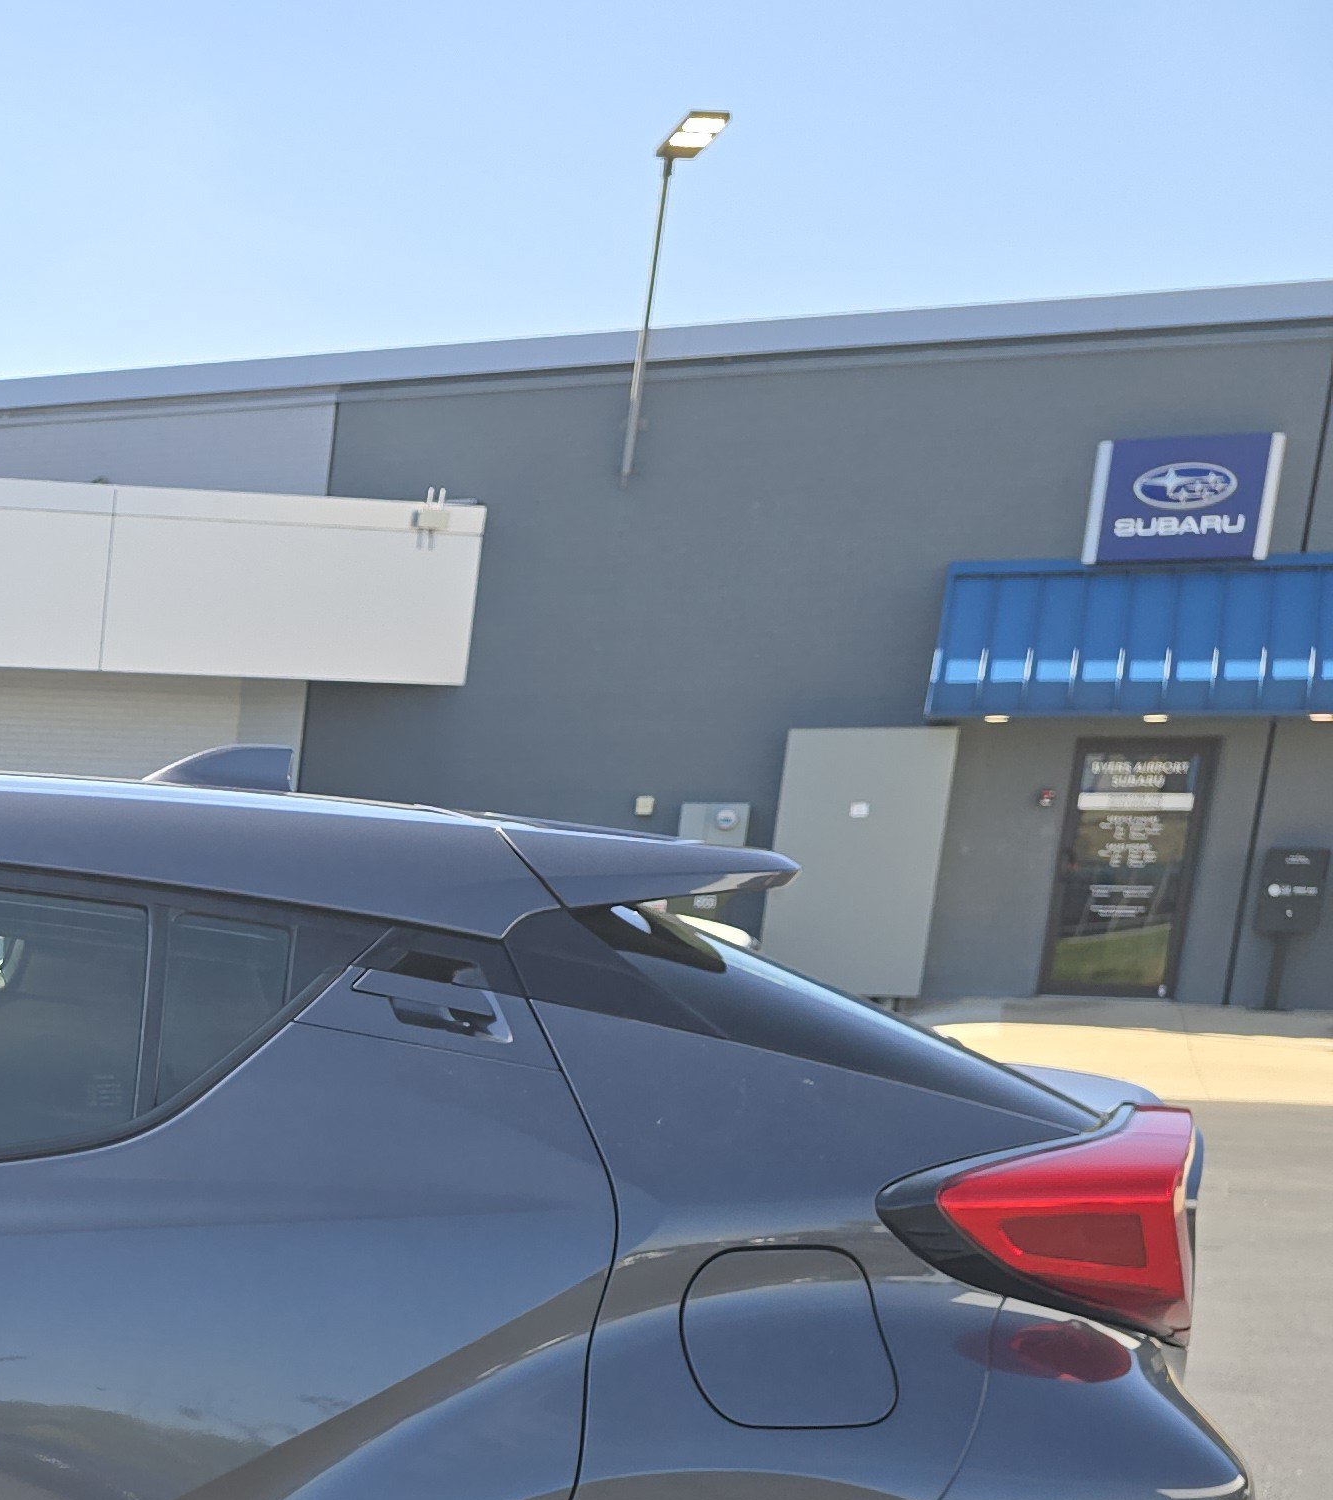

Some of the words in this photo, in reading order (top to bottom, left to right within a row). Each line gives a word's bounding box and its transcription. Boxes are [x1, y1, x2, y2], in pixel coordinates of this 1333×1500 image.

[1113, 513, 1246, 538] SUBARU
[1133, 761, 1190, 775] AIRPORT
[1112, 774, 1166, 788] SUBARU
